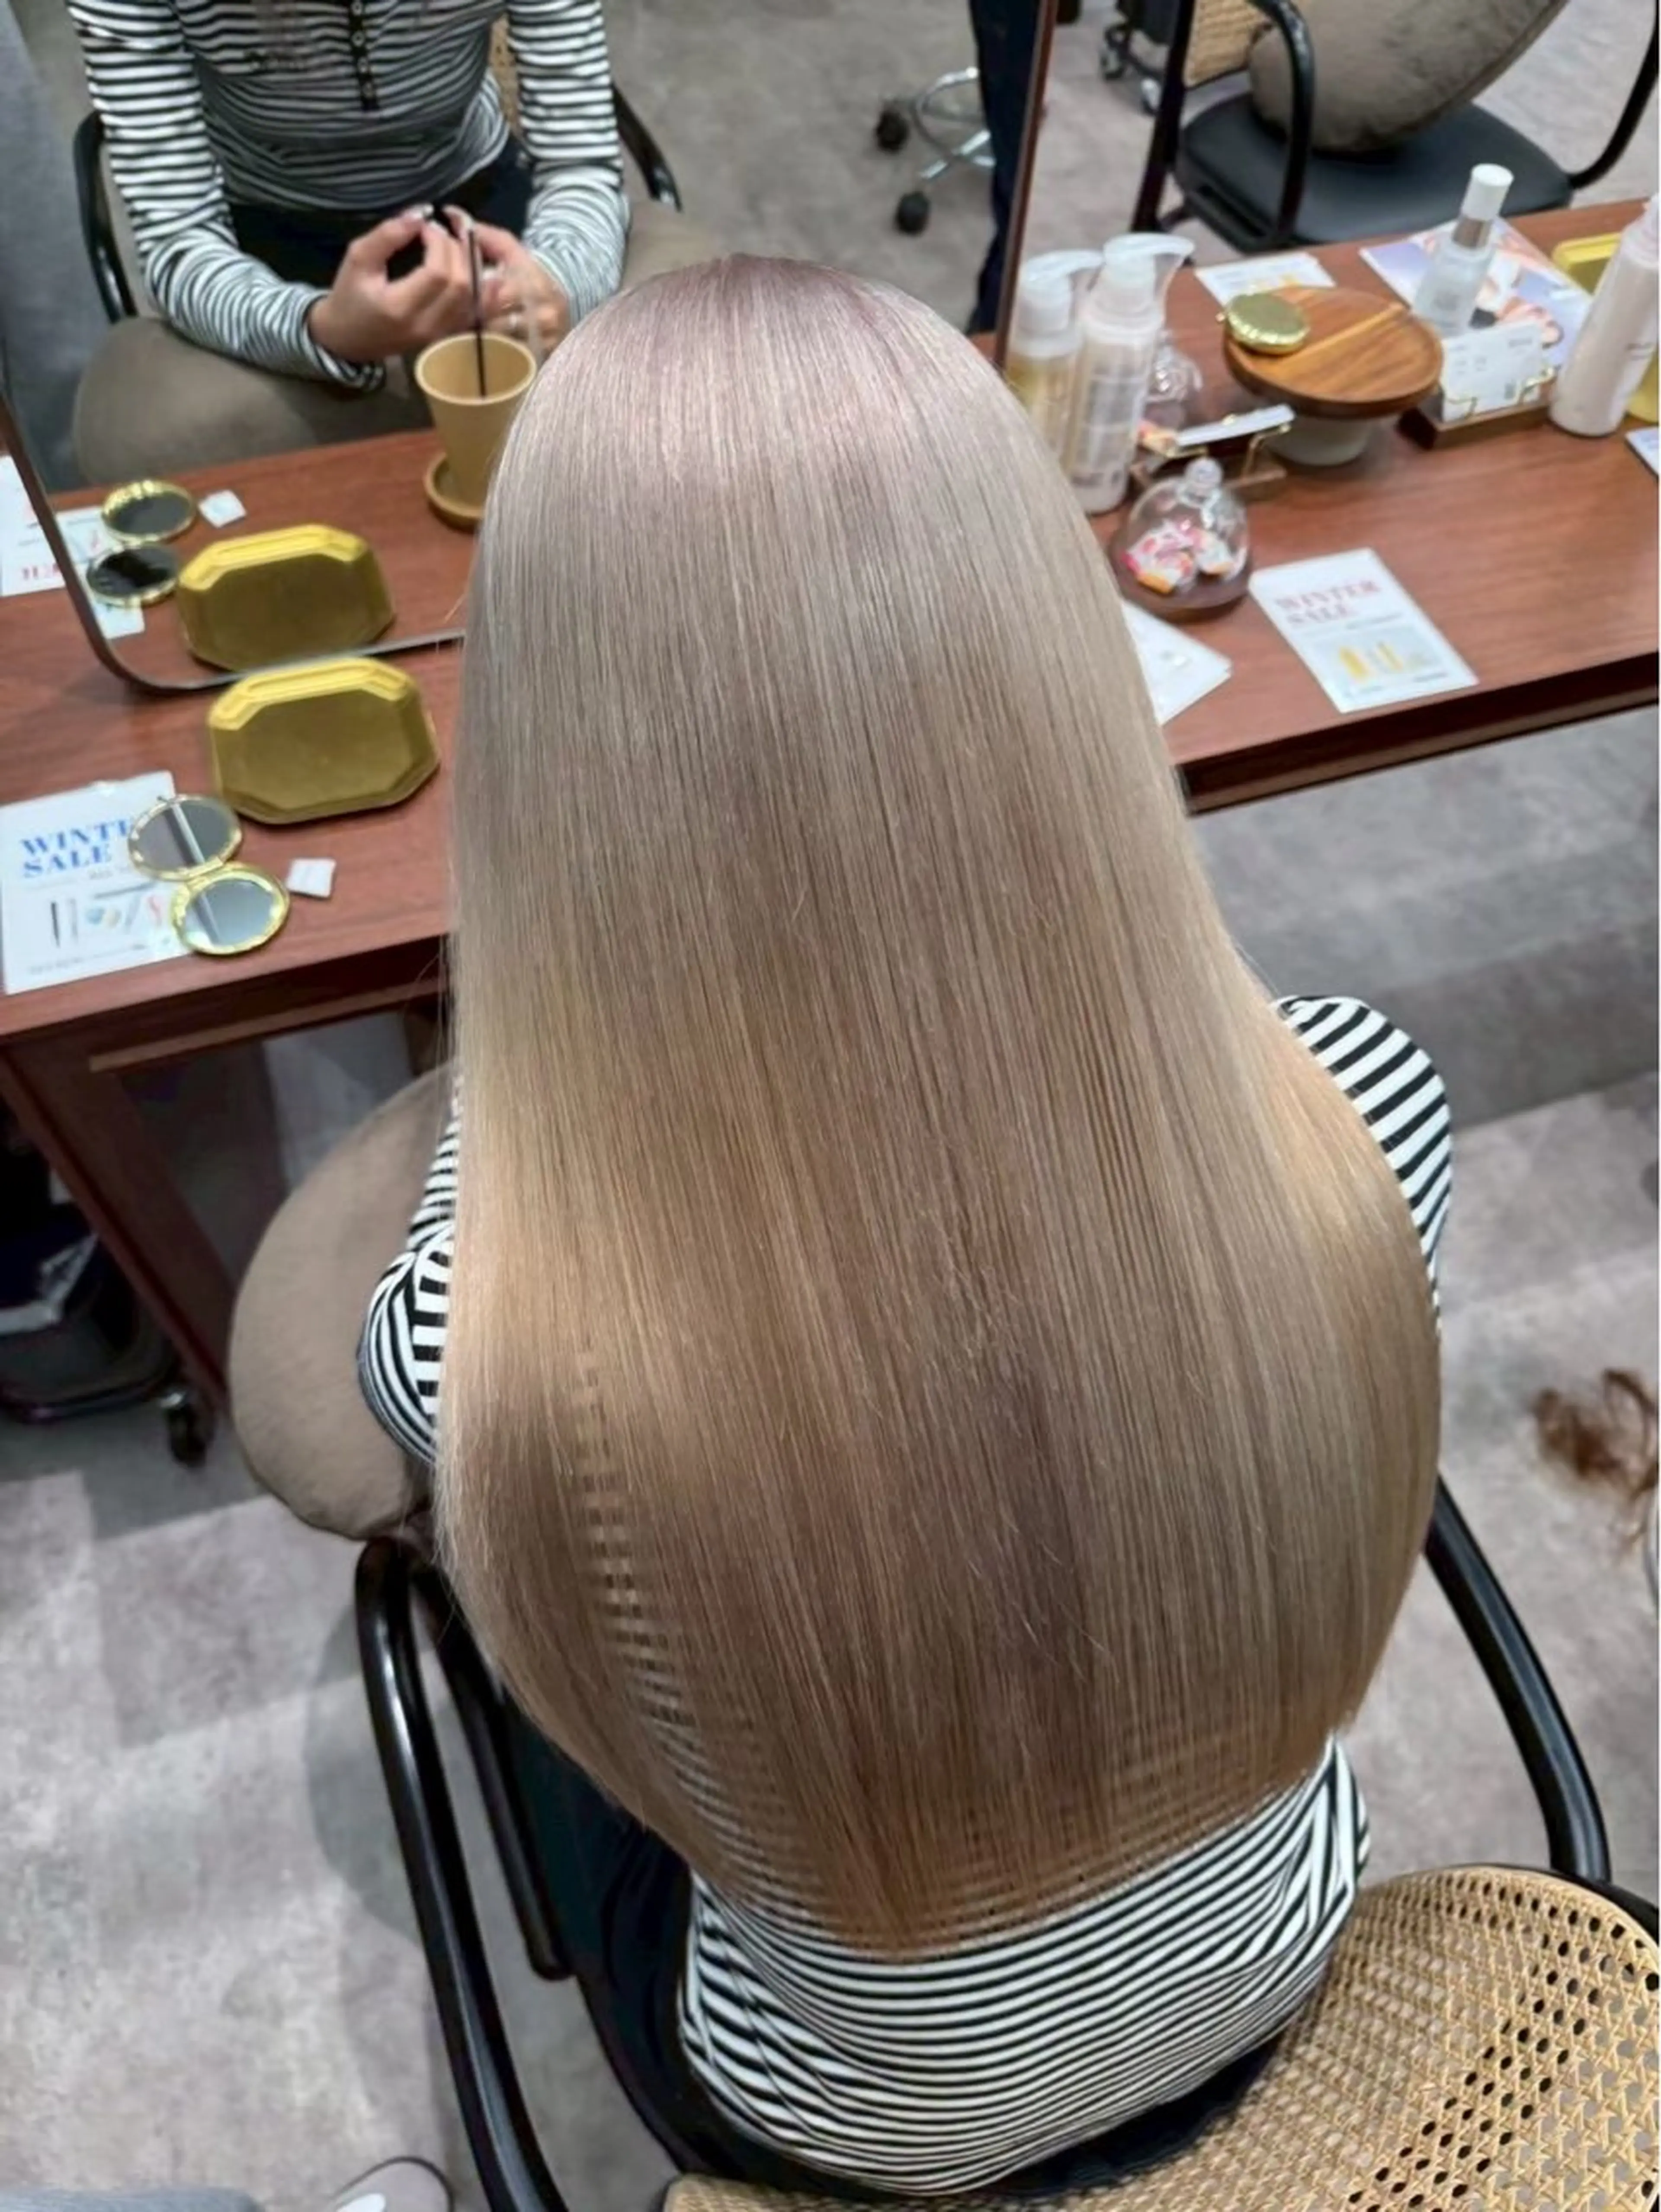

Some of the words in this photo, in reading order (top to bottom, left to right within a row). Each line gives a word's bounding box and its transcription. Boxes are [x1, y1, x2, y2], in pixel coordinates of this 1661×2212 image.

[1275, 580, 1382, 609] WINTER
[21, 819, 131, 855] WINTE
[23, 845, 112, 878] SALE
